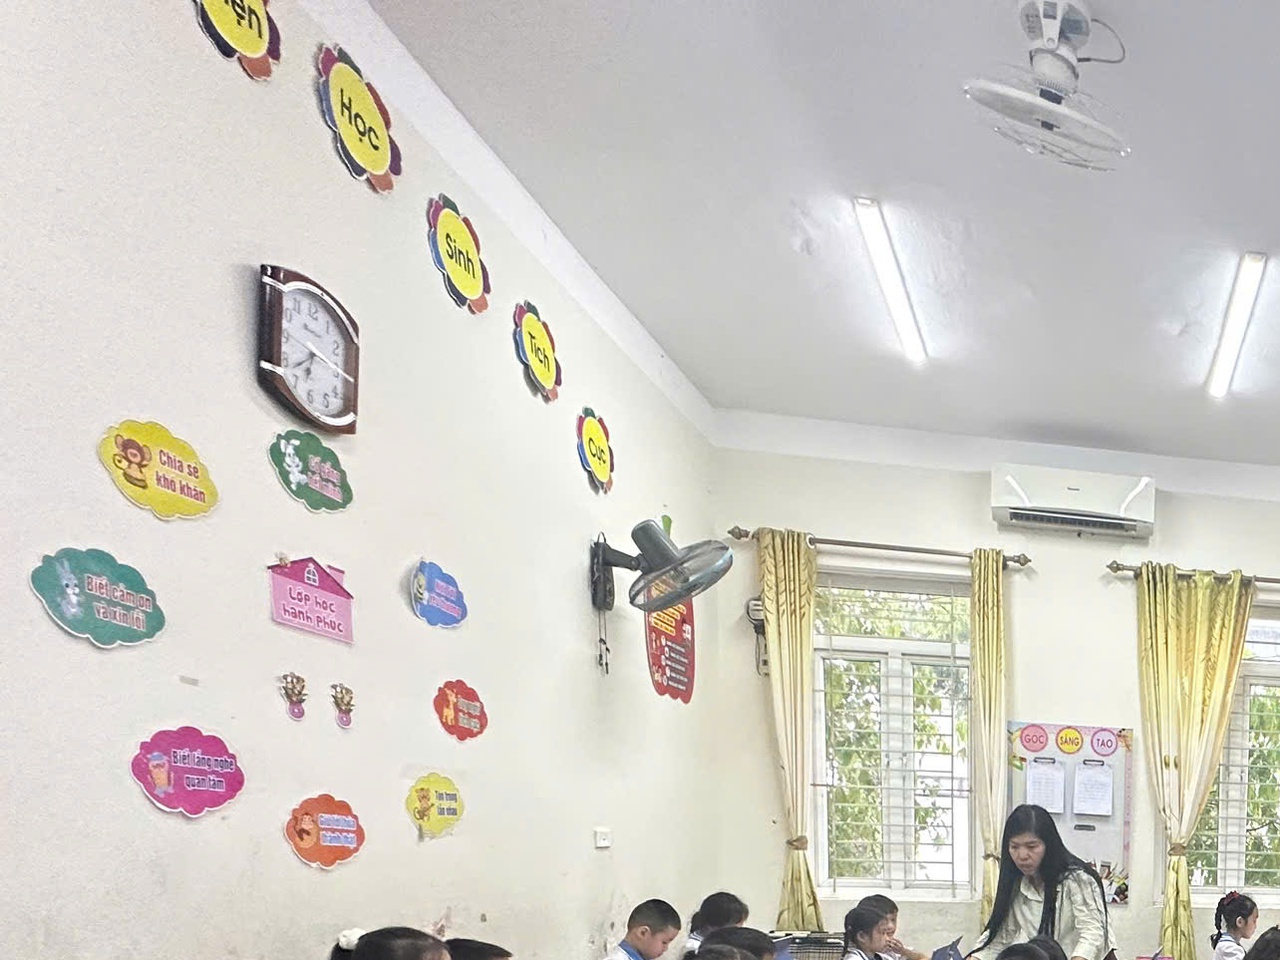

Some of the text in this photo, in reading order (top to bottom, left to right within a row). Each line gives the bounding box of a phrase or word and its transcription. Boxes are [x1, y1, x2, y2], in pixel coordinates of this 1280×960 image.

[340, 88, 379, 151] Học
[445, 233, 476, 279] Sinh
[159, 449, 184, 473] Chia
